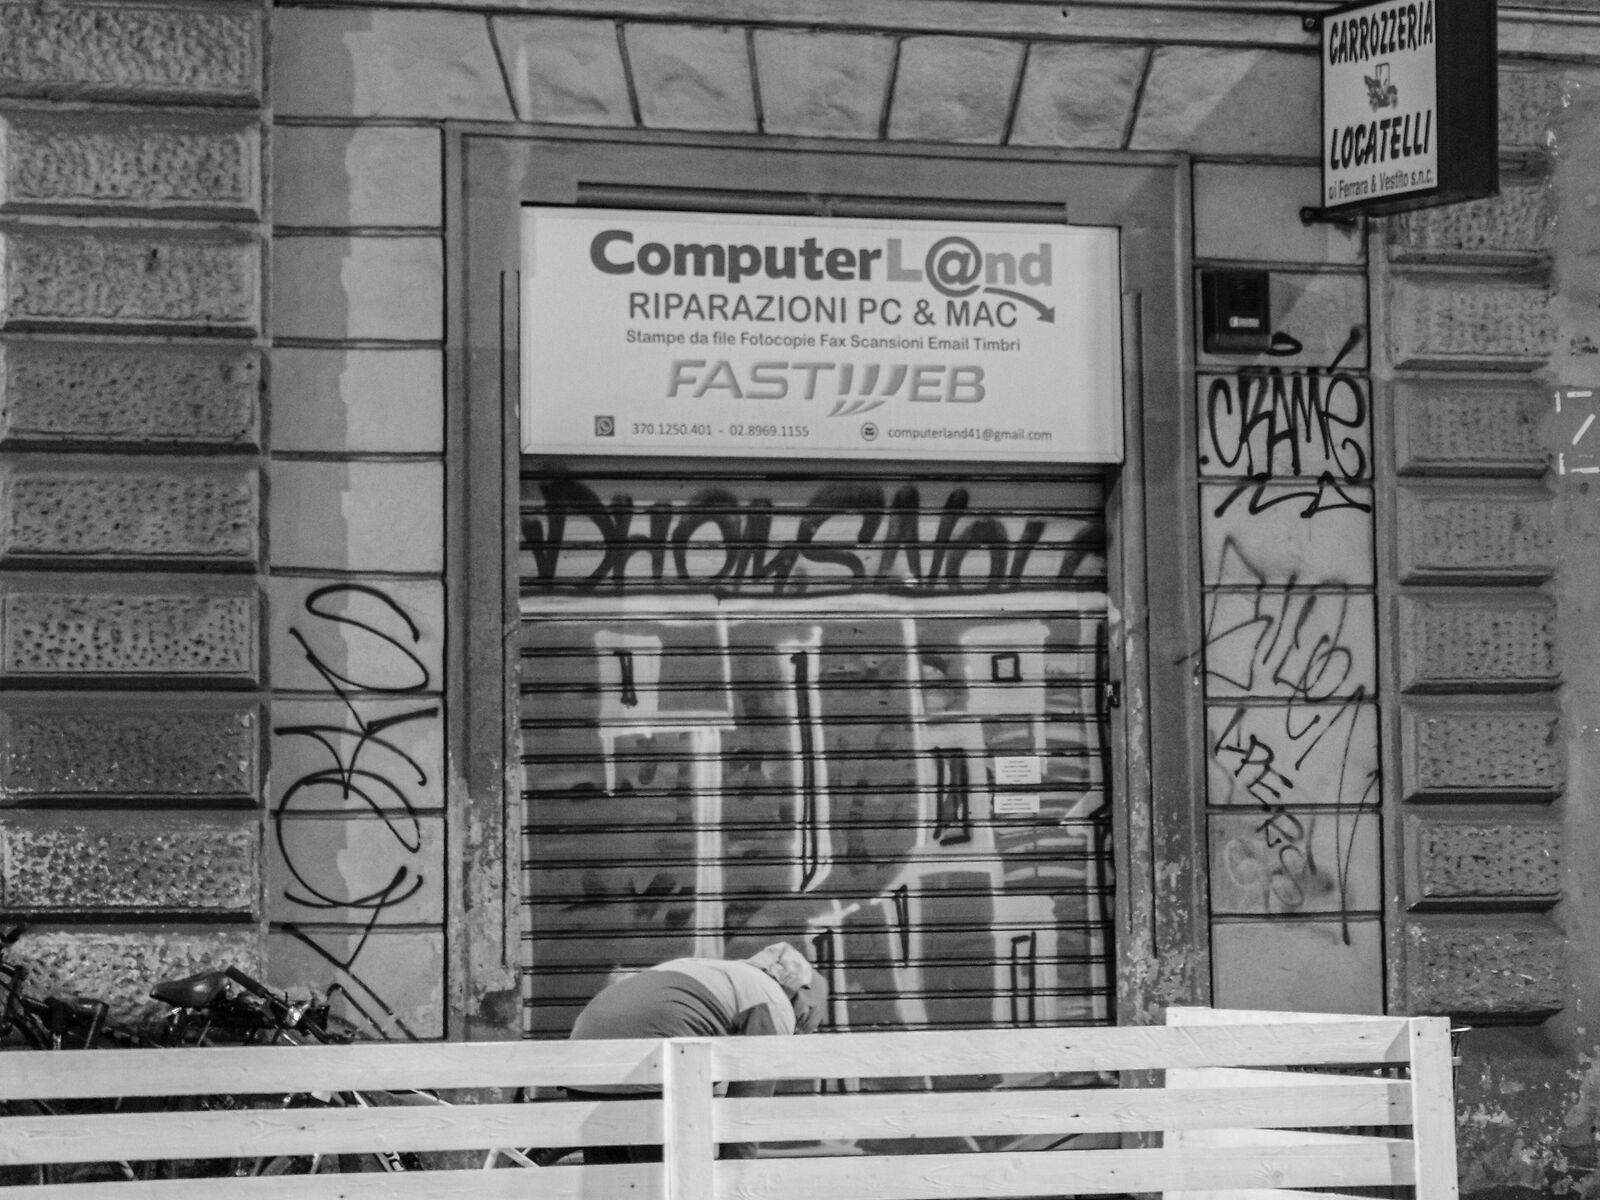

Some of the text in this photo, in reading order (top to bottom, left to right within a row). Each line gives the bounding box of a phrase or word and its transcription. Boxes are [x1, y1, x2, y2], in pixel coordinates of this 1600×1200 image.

[1329, 0, 1433, 66] CARROZZERIA
[1330, 109, 1432, 171] LOCATELLI
[1339, 179, 1369, 199] Ferrara
[1371, 173, 1377, 193] &
[629, 291, 1018, 328] RIPARAZIONI PC & MAC
[626, 329, 1021, 352] Stampe da file Fotocopie Fax Scansioni Email Timbri
[665, 359, 987, 418] FASTWEB
[631, 423, 713, 436] 370.1250.401
[728, 424, 810, 438] 02.8969.1155
[887, 426, 1053, 442] computerland41@gmail.com
